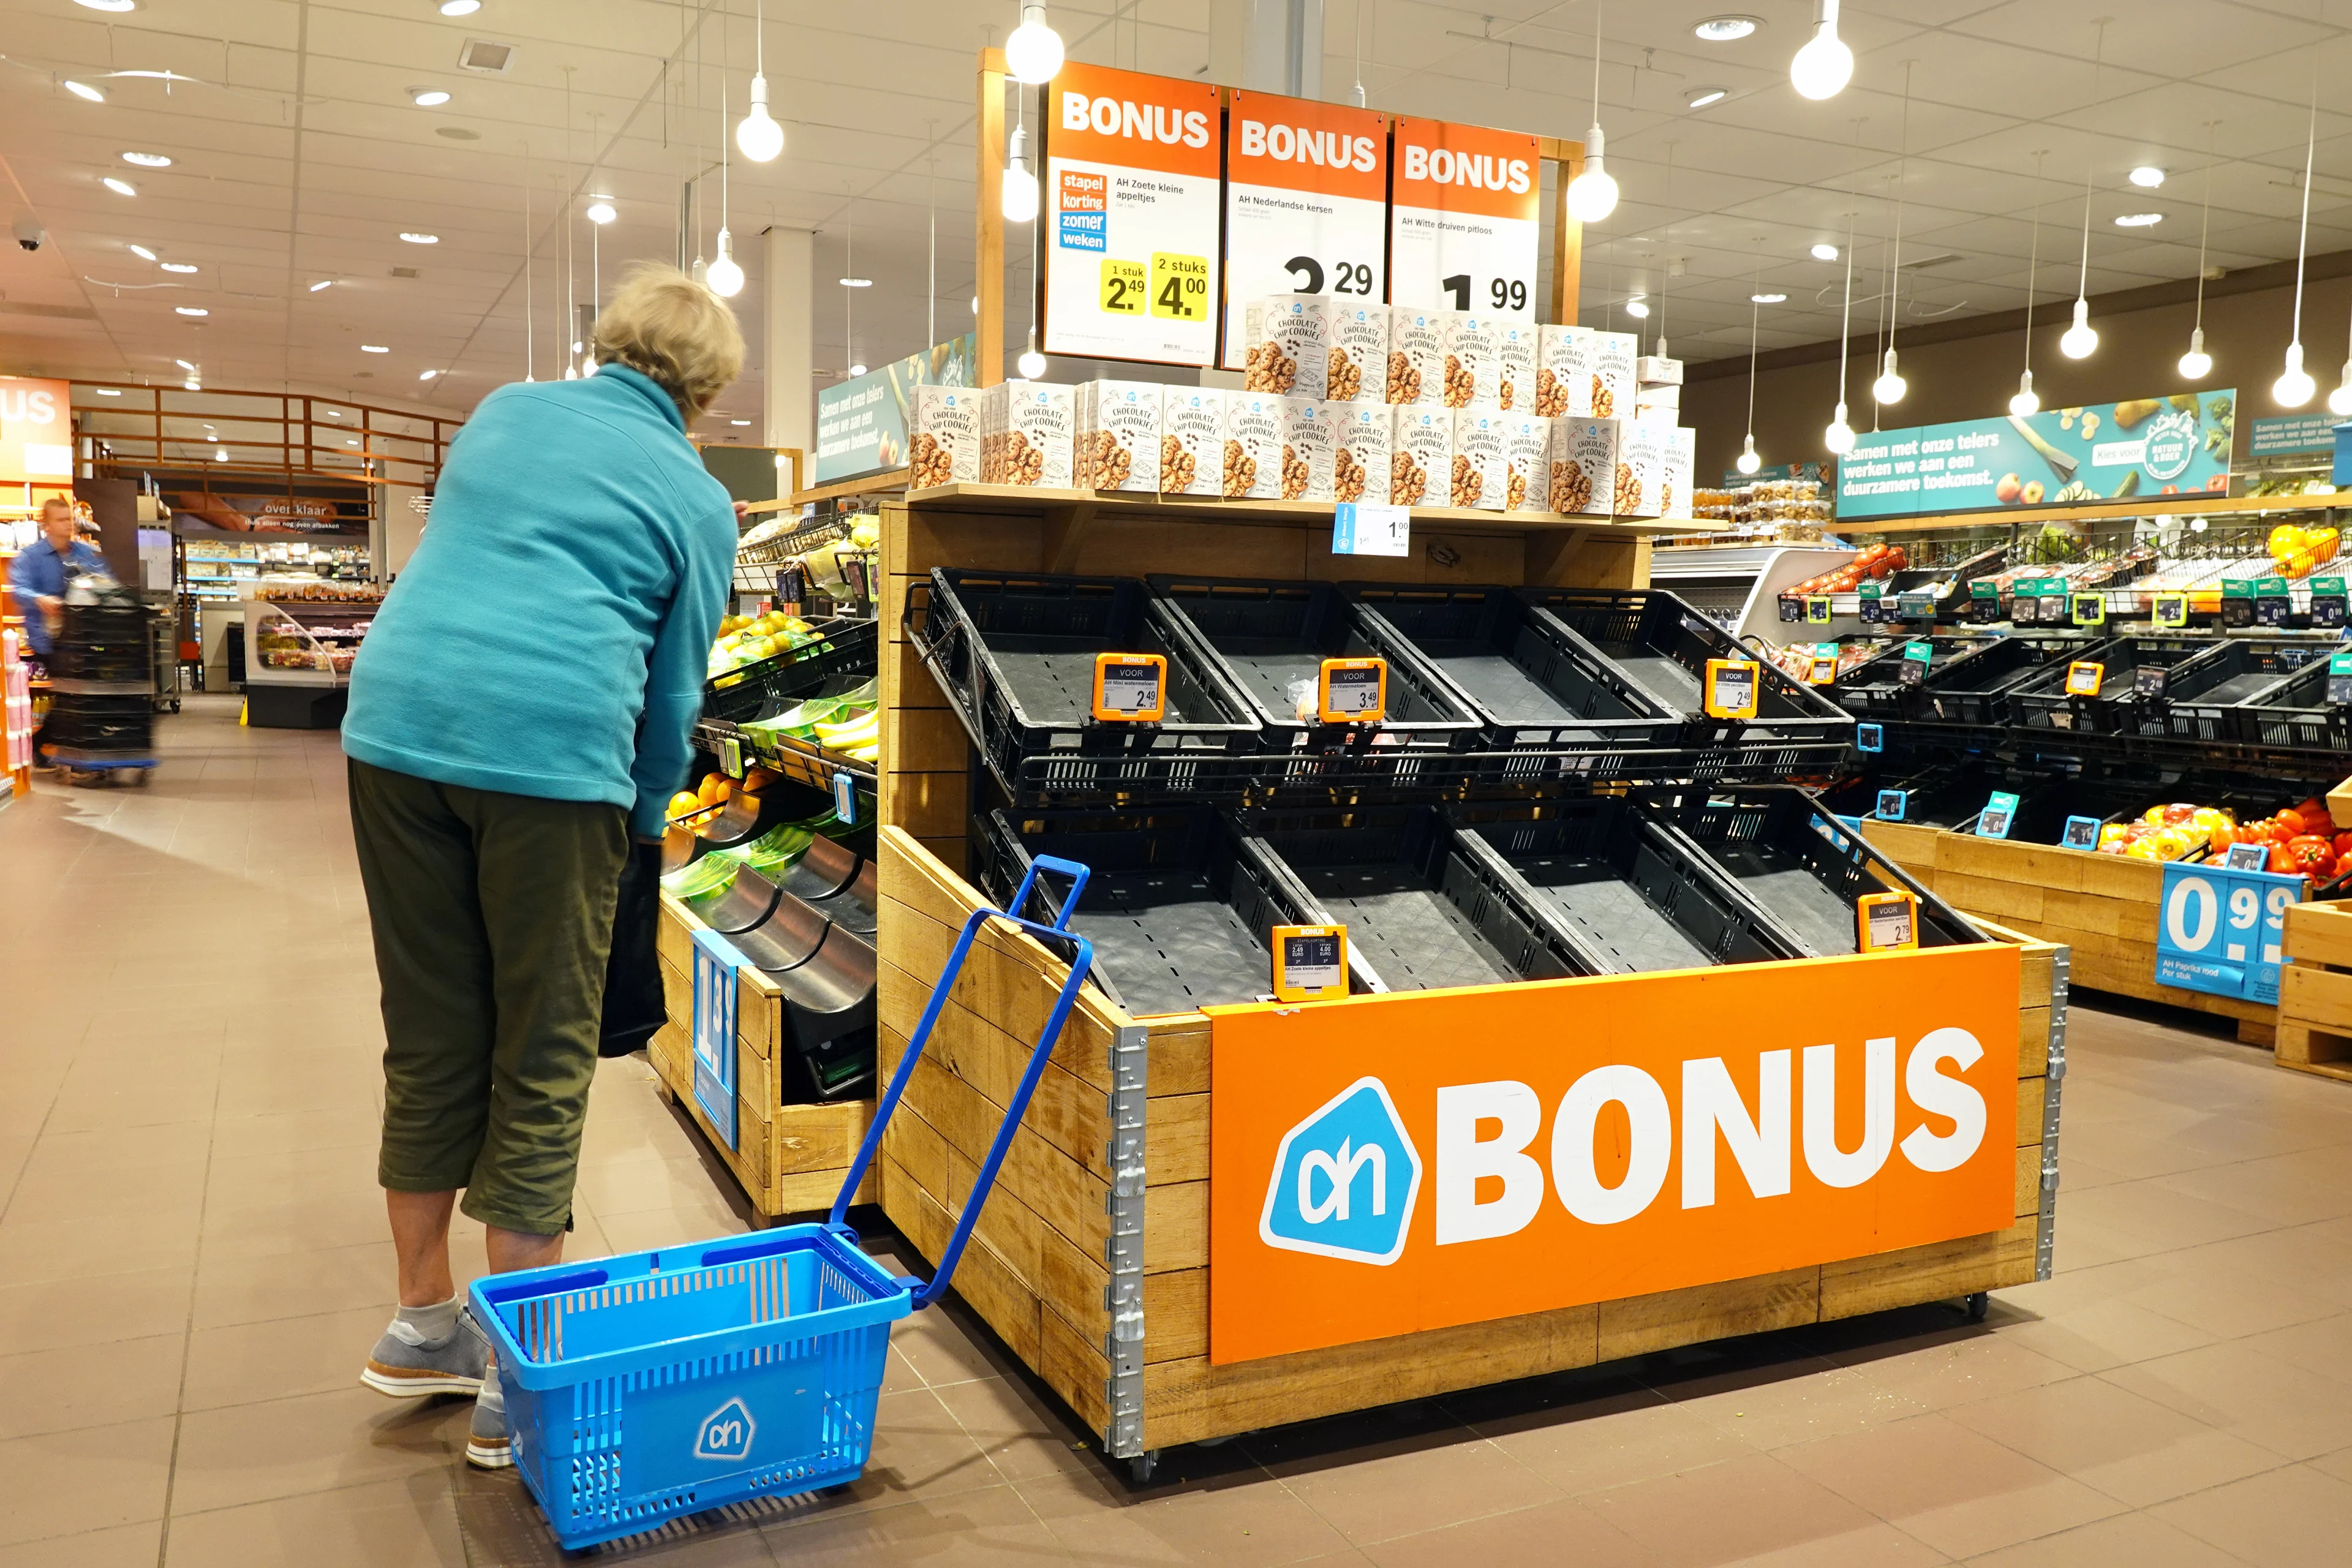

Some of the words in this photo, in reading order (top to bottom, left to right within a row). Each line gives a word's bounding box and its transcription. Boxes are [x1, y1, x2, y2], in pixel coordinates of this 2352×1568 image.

[1063, 91, 1208, 148] BONUS
[1242, 120, 1376, 172] BONUS
[1405, 145, 1530, 194] BONUS
[1064, 175, 1102, 190] stapel
[1132, 179, 1155, 190] Zoete
[1159, 183, 1183, 194] kleine
[1063, 192, 1102, 209] korting
[1116, 191, 1155, 203] appeltjes
[1239, 195, 1250, 203] AH
[1253, 197, 1303, 210] Nederlandse
[1306, 203, 1333, 214] kersen
[1063, 215, 1103, 230] zomer
[1415, 219, 1435, 228] Witte
[1438, 221, 1465, 231] druiven
[1468, 225, 1492, 235] pitloos
[1063, 233, 1102, 247] weken
[1123, 268, 1144, 277] stuk
[1159, 258, 1166, 269] 2
[1172, 262, 1206, 274] stuks
[1278, 319, 1318, 330] CHOCOLATE
[1274, 330, 1287, 339] CHIP
[1289, 328, 1322, 340] COOKIES
[1344, 326, 1379, 337] CHOCOLATE
[1405, 331, 1438, 343] CHOCOLATE
[1340, 336, 1352, 345] CHIP
[1354, 335, 1381, 348] COOKIES
[1457, 334, 1491, 345] CHOCOLATE
[1401, 341, 1413, 350] CHIP
[1415, 340, 1439, 353] COOKIES
[1453, 344, 1465, 353] CHIP
[1466, 342, 1493, 355] COOKIES
[1507, 353, 1531, 365] COOKIES
[1553, 349, 1584, 359] CHOCOLATE
[1599, 355, 1628, 364] CHOCOLATE
[1550, 358, 1561, 367] CHIP
[1562, 357, 1586, 369] COOKIES
[1608, 363, 1630, 374] COOKIES
[821, 401, 839, 419] Samen
[840, 394, 851, 413] met
[852, 390, 865, 409] onze
[867, 384, 884, 402] telers
[933, 412, 971, 423] CHOCOLATE
[1024, 408, 1063, 420] CHOCOLATE
[1113, 407, 1152, 420] CHOCOLATE
[1178, 413, 1215, 424] CHOCOLATE
[820, 421, 840, 439] werken
[841, 420, 850, 431] we
[850, 415, 861, 428] aan
[862, 410, 872, 424] een
[929, 422, 942, 431] CHIP
[943, 420, 974, 433] COOKIES
[1020, 419, 1033, 429] CHIP
[1035, 417, 1066, 431] COOKIES
[1109, 418, 1122, 428] CHIP
[1124, 417, 1154, 431] COOKIES
[1174, 423, 1187, 432] CHIP
[1188, 421, 1217, 435] COOKIES
[1240, 418, 1275, 429] CHOCOLATE
[1292, 423, 1327, 435] CHOCOLATE
[1235, 428, 1248, 437] CHIP
[1250, 426, 1276, 440] COOKIES
[1288, 434, 1301, 442] CHIP
[1302, 432, 1330, 445] COOKIES
[1349, 427, 1384, 439] CHOCOLATE
[1411, 431, 1444, 441] CHOCOLATE
[1468, 434, 1501, 445] CHOCOLATE
[819, 439, 850, 459] duurzamere
[851, 427, 879, 450] toekomst.
[1359, 435, 1385, 448] COOKIES
[1407, 441, 1419, 451] CHIP
[1420, 439, 1446, 451] COOKIES
[1510, 439, 1543, 449] CHOCOLATE
[1578, 440, 1608, 451] CHOCOLATE
[1844, 446, 1888, 461] Samen
[1891, 440, 1918, 457] met
[1921, 438, 1954, 454] onze
[1958, 432, 2000, 450] telers
[2303, 437, 2335, 445] toekom
[1464, 445, 1476, 453] CHIP
[1477, 442, 1503, 454] COOKIES
[1519, 447, 1544, 458] COOKIES
[1574, 450, 1586, 459] CHIP
[1586, 448, 1610, 461] COOKIES
[2098, 450, 2116, 459] Kies
[2120, 448, 2141, 457] voor
[2152, 443, 2183, 454] NATUUR
[1844, 461, 1891, 479] werken
[1895, 461, 1915, 474] we
[1918, 458, 1944, 472] aan
[1948, 455, 1974, 469] een
[1843, 478, 1920, 496] duurzamere
[1924, 470, 1994, 489] toekomst.
[296, 505, 326, 516] klaar
[2176, 961, 2200, 974] Paprika
[2203, 968, 2219, 977] rood
[2176, 971, 2191, 981] stuk
[1435, 1026, 1988, 1246] BONUS
